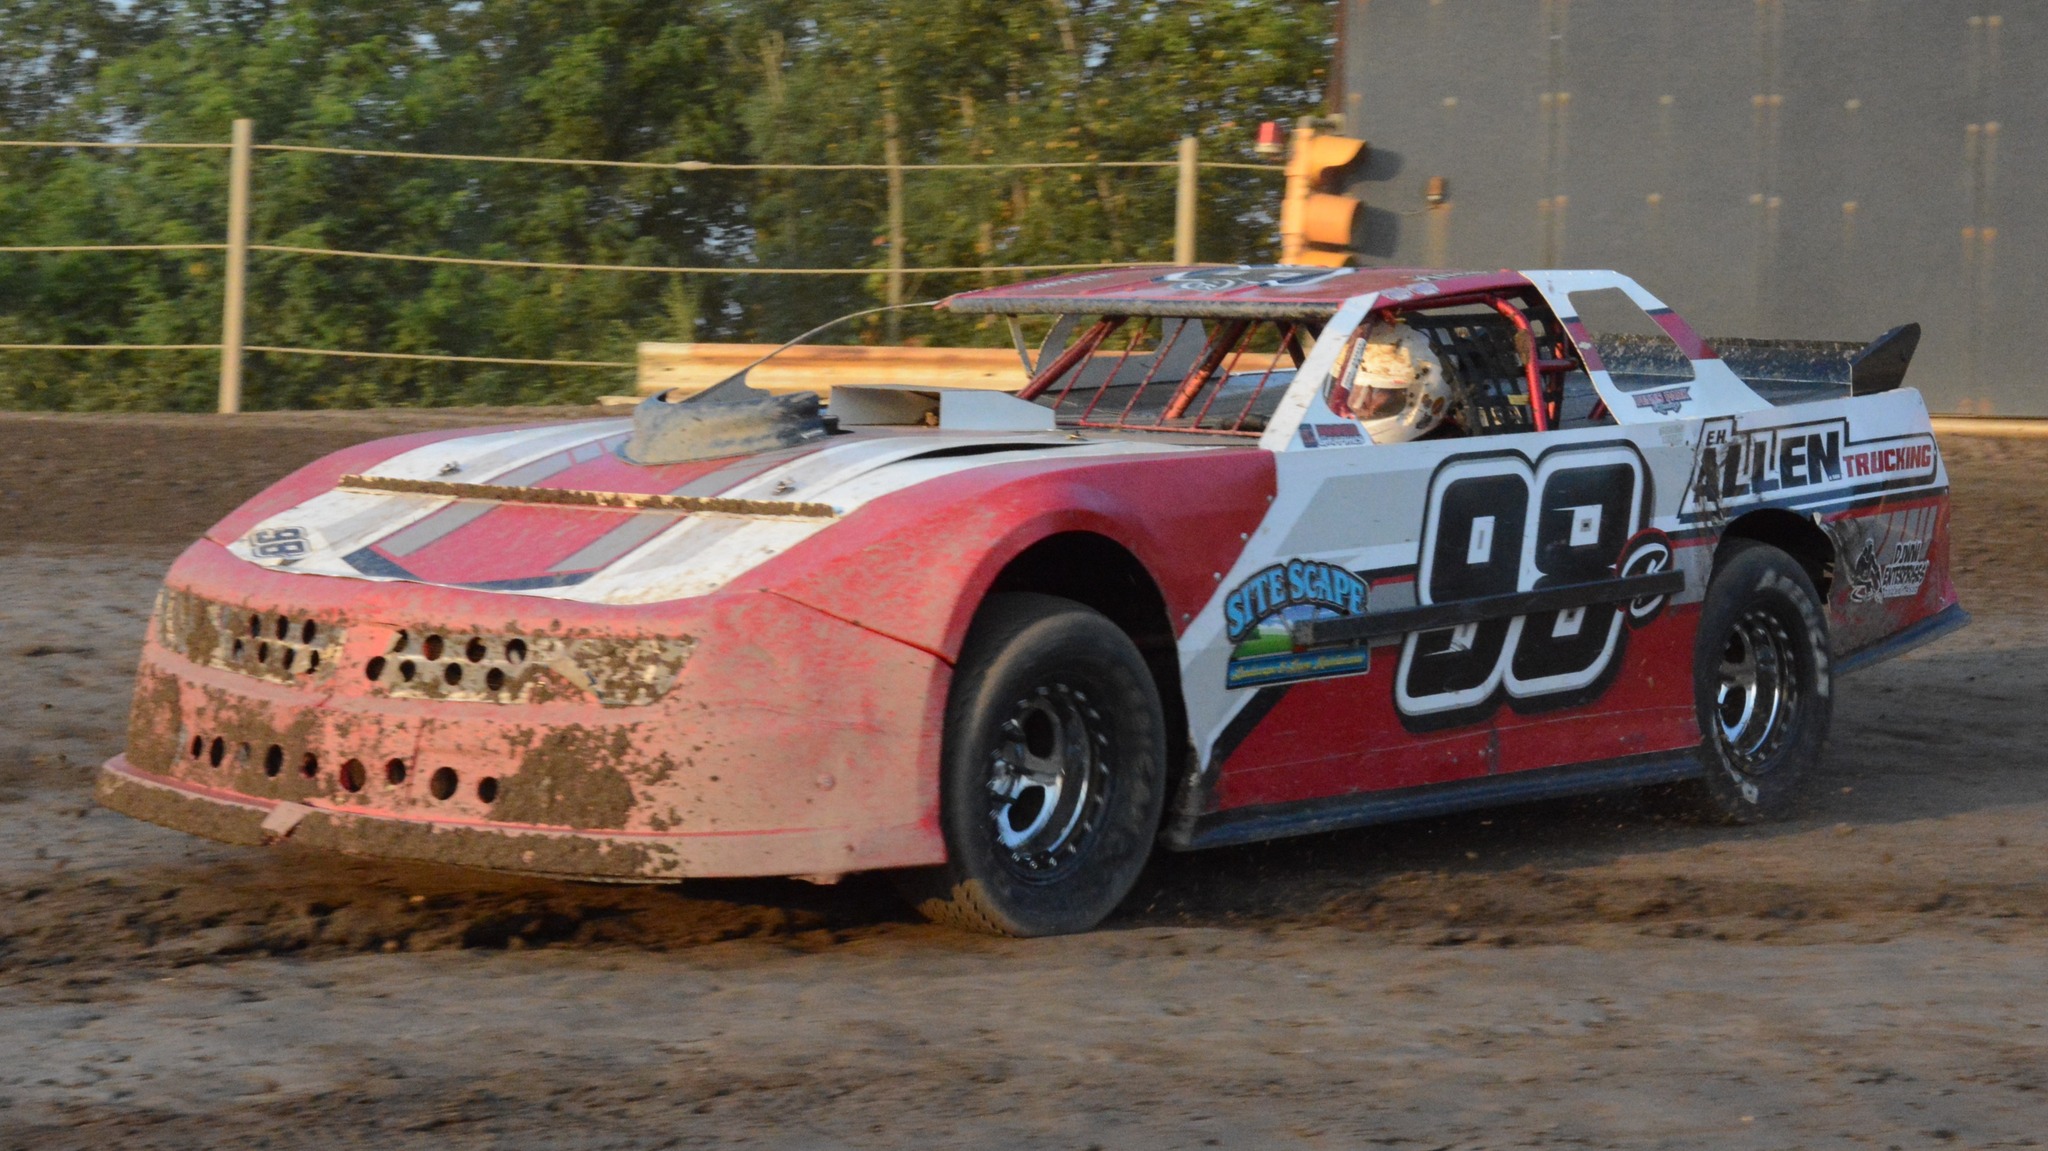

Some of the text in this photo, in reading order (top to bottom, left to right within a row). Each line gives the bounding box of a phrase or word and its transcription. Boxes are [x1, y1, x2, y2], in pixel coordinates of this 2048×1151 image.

[1693, 430, 1932, 503] ALLEN TRUCKING
[1225, 561, 1366, 639] SITE SCAPE
